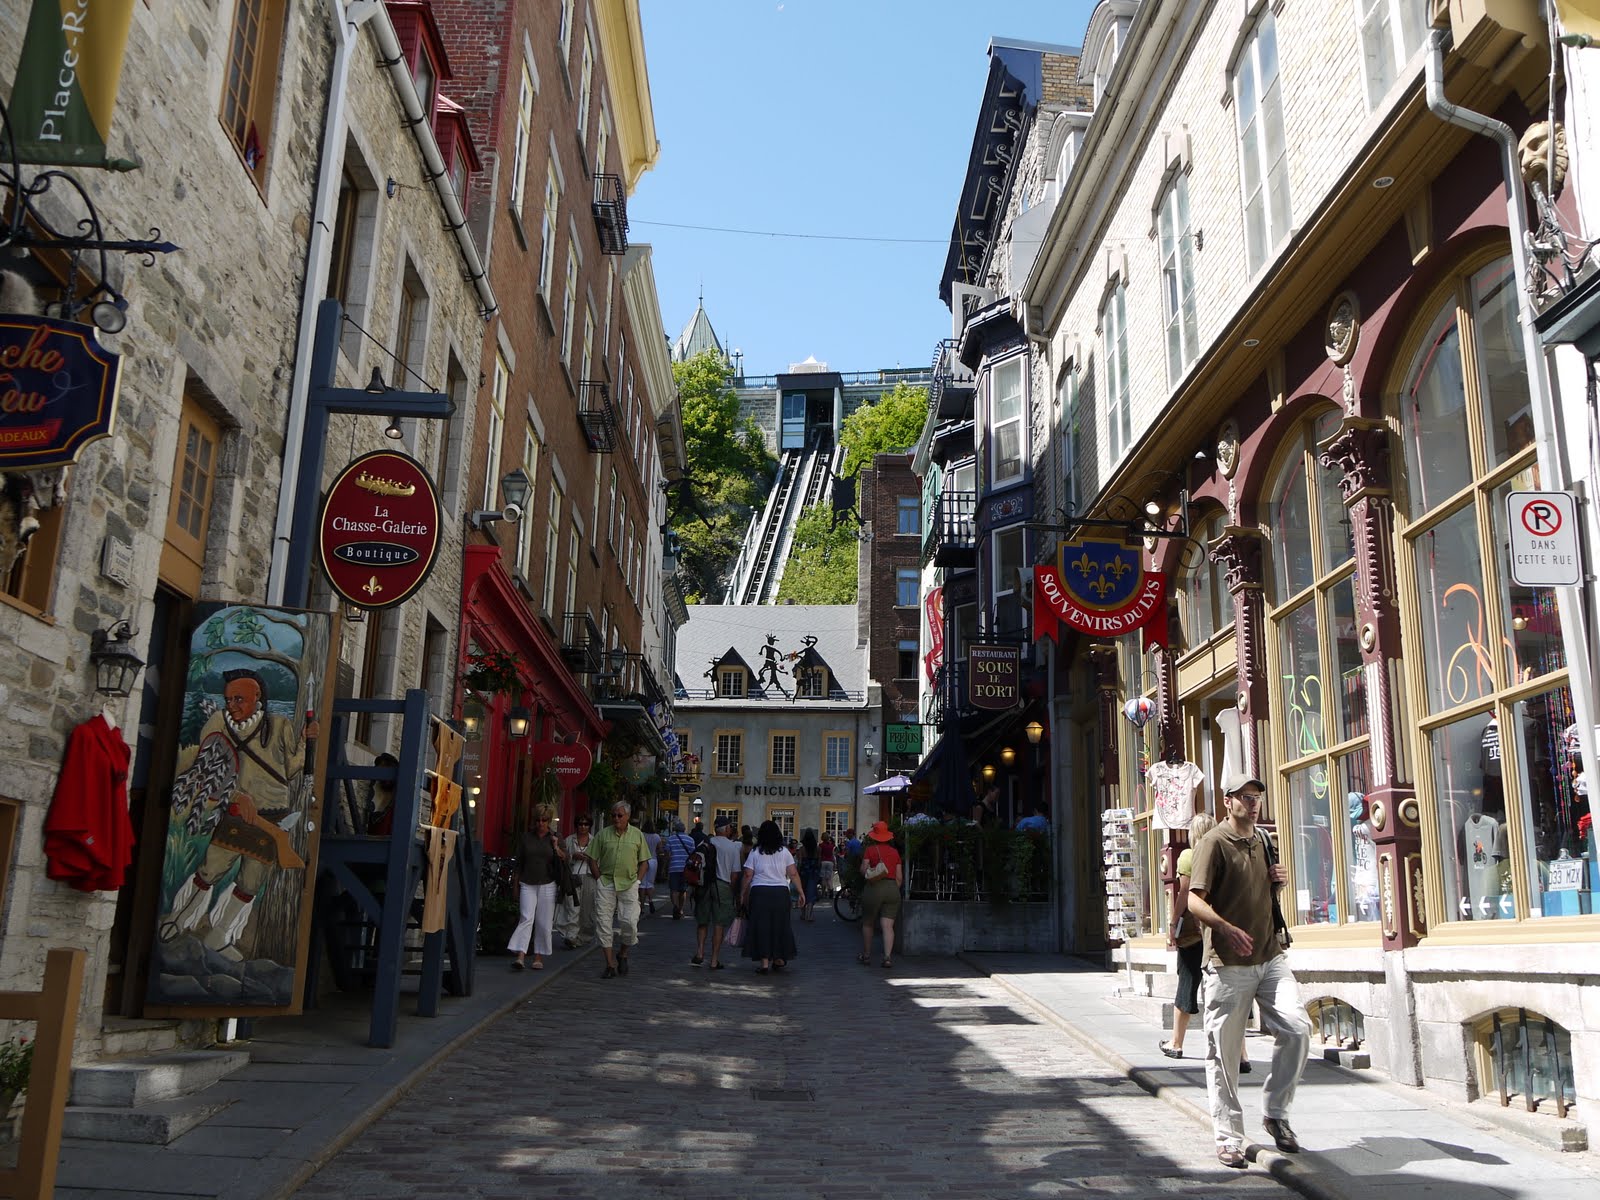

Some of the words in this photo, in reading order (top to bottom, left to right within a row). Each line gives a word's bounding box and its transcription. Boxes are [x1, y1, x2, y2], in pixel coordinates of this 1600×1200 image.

[374, 505, 389, 518] La
[332, 516, 428, 535] Chasse-Galerie
[1531, 540, 1556, 550] DANS
[346, 546, 408, 562] Boutique
[1517, 554, 1546, 565] CETTE
[1553, 554, 1573, 565] RUE
[1040, 573, 1124, 630] SOUVENIRS
[1123, 605, 1143, 625] DU
[1138, 579, 1160, 610] LYS
[971, 649, 1017, 659] RESTAURANT
[976, 661, 1013, 674] SOUS
[989, 674, 1001, 683] LE
[974, 684, 1016, 698] FORT
[735, 785, 831, 797] FUNICULAIRE
